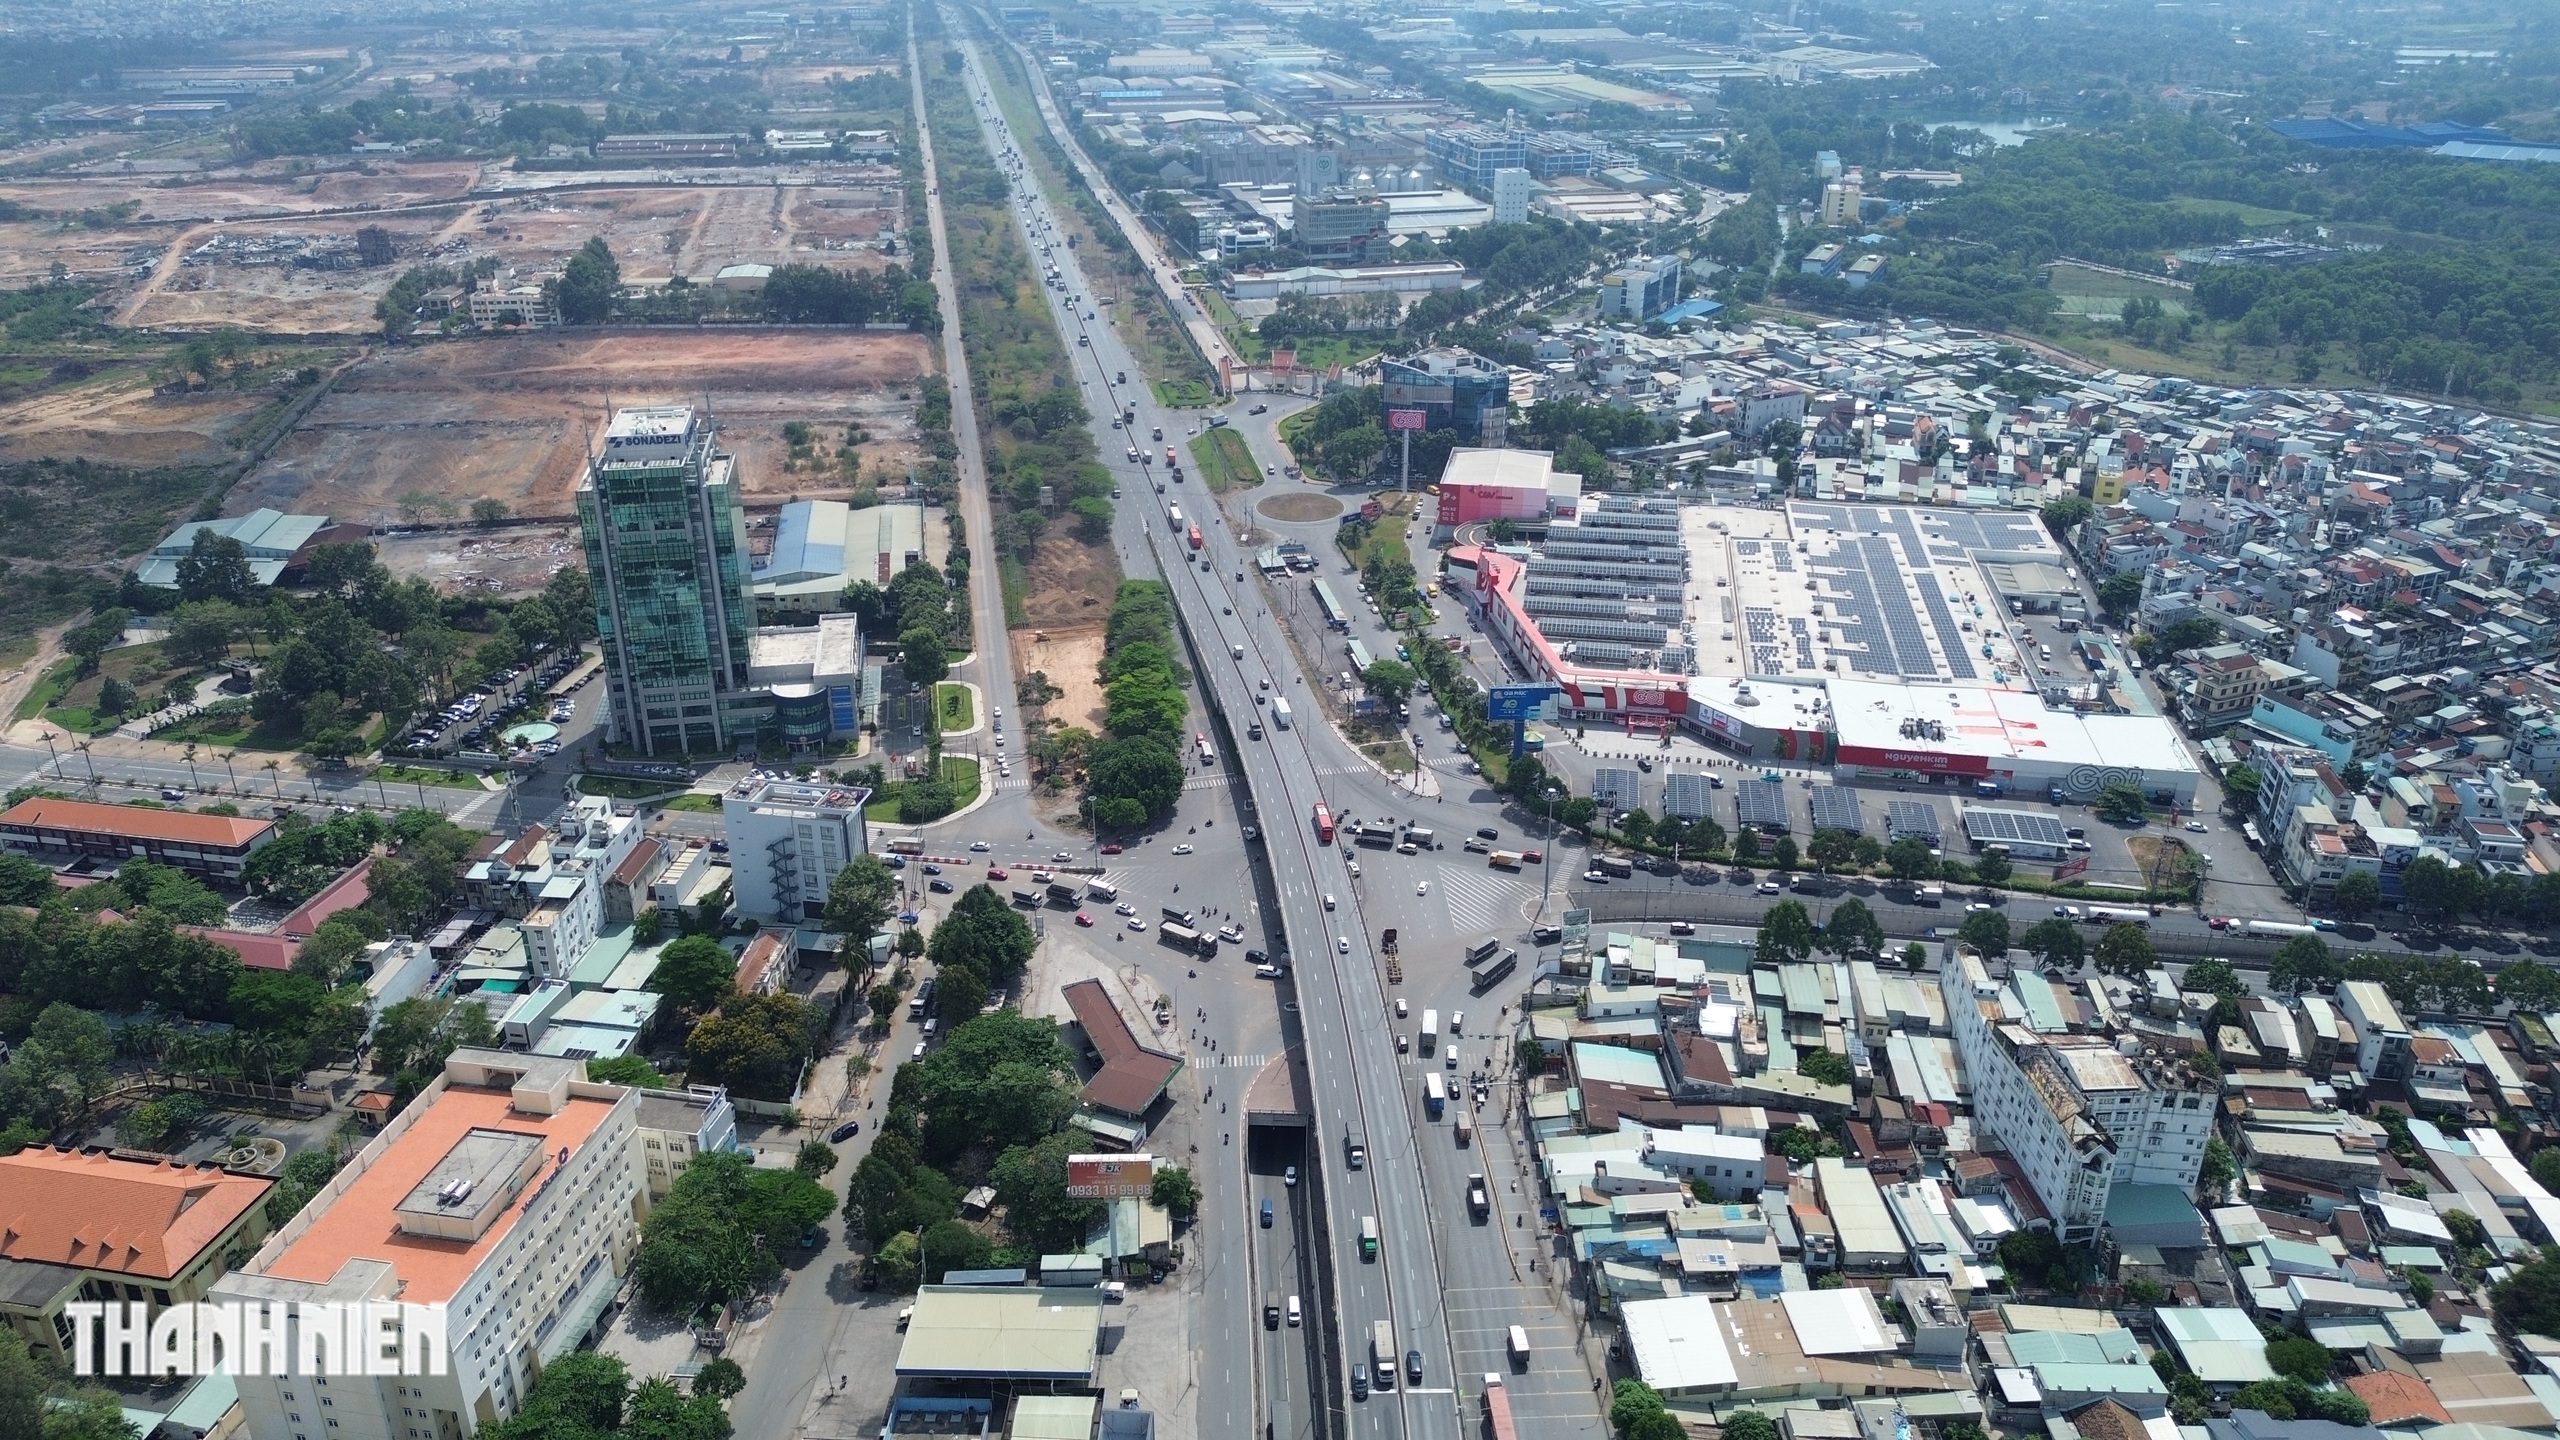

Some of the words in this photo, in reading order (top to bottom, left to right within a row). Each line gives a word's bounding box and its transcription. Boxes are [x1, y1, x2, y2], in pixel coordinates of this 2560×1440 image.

[1392, 412, 1422, 428] GO!
[625, 435, 681, 446] SONADEZI
[1478, 491, 1496, 499] CGV
[1633, 689, 1665, 705] GO!
[1071, 1185, 1100, 1195] 0933
[1104, 1185, 1117, 1195] 15
[1120, 1185, 1134, 1195] 99
[1137, 1184, 1151, 1195] 88
